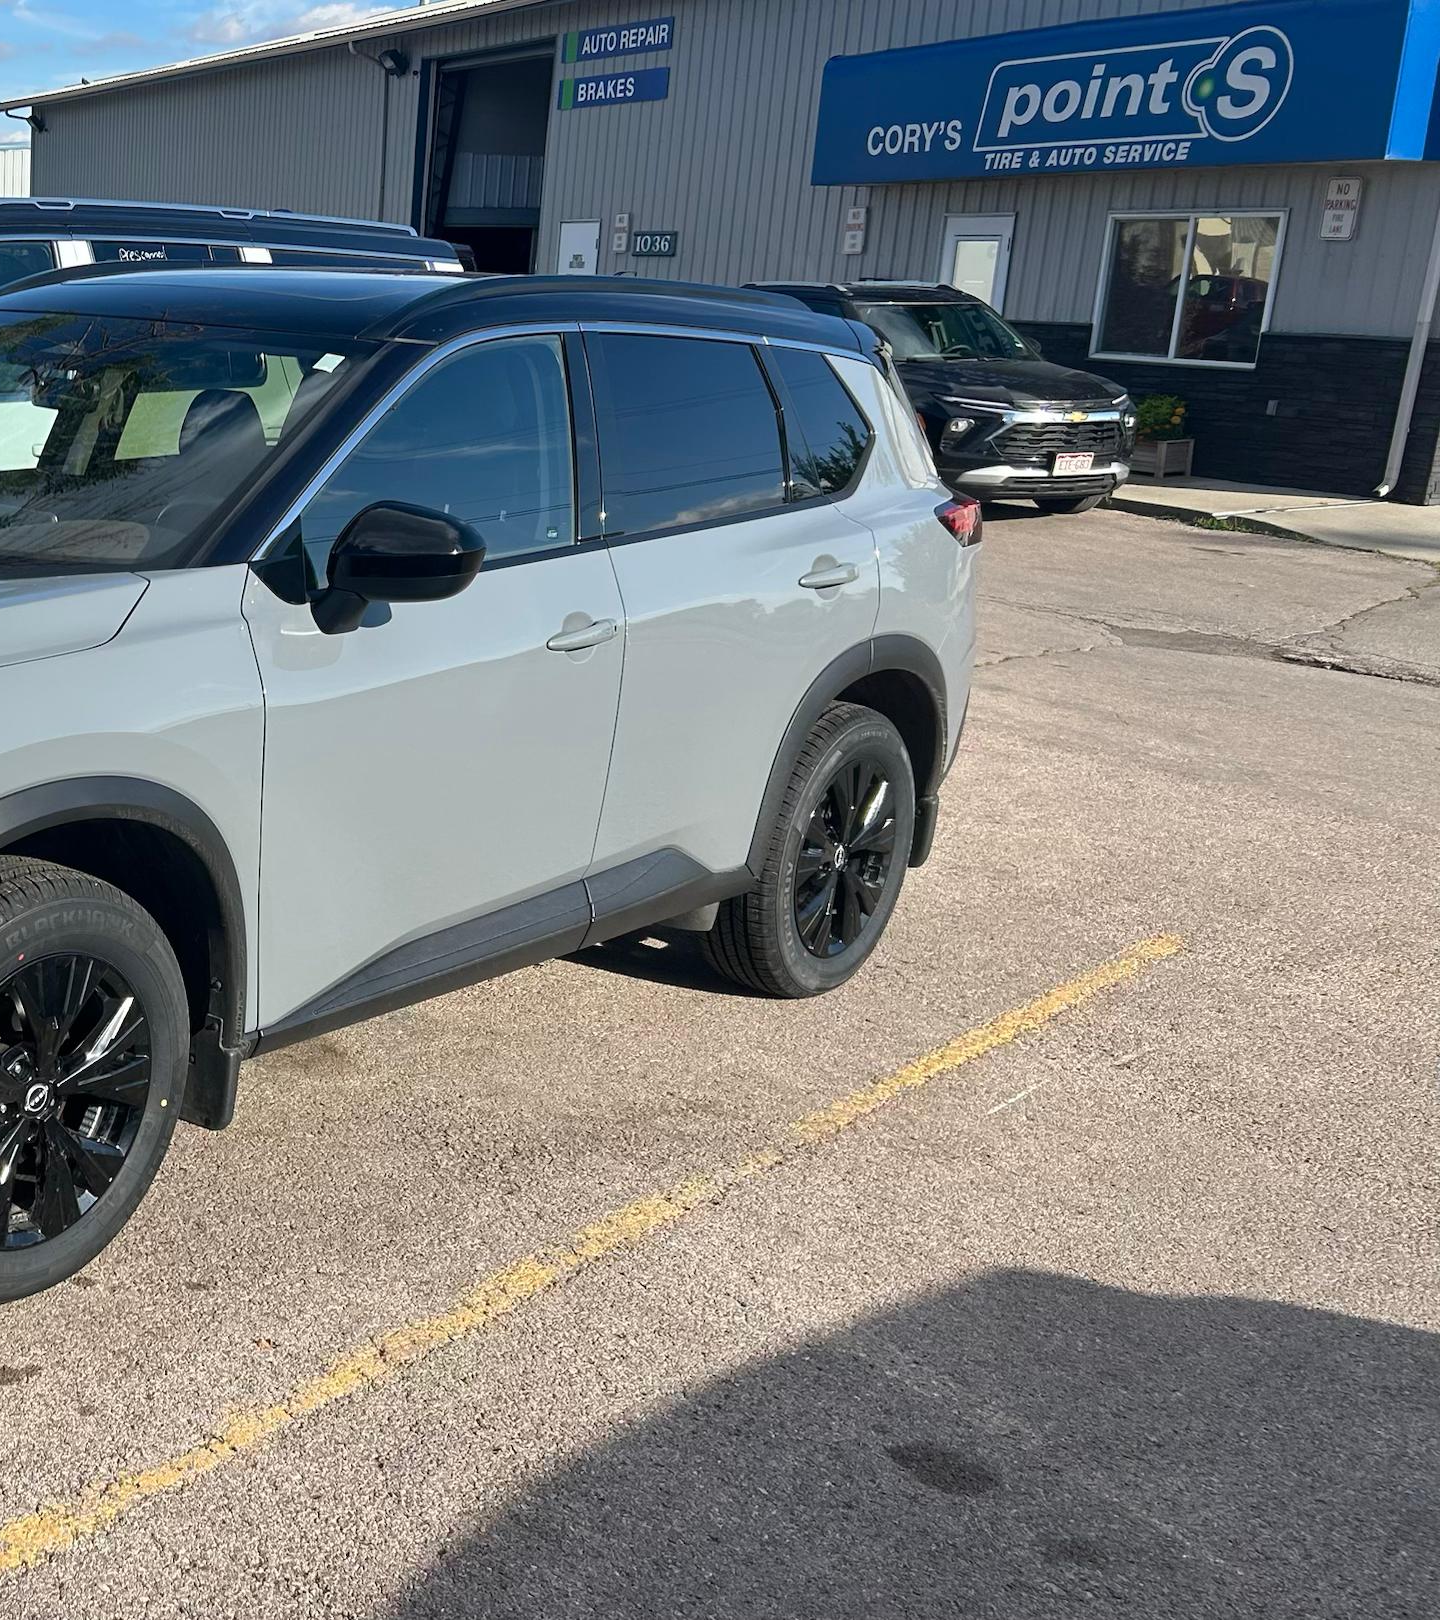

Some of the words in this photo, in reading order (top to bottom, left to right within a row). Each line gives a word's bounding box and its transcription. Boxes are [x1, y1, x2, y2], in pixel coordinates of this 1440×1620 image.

[582, 32, 617, 55] AUTO
[620, 24, 669, 50] REPAIR
[577, 77, 635, 102] BRAKES
[997, 57, 1179, 138] point
[1216, 46, 1278, 120] S
[867, 119, 963, 157] CORY'S
[984, 151, 1023, 170] TIRE
[1028, 151, 1040, 168] &
[1045, 147, 1098, 167] AUTO
[1103, 141, 1192, 163] SERVICE
[1336, 184, 1350, 195] NO
[636, 235, 671, 252] 1036
